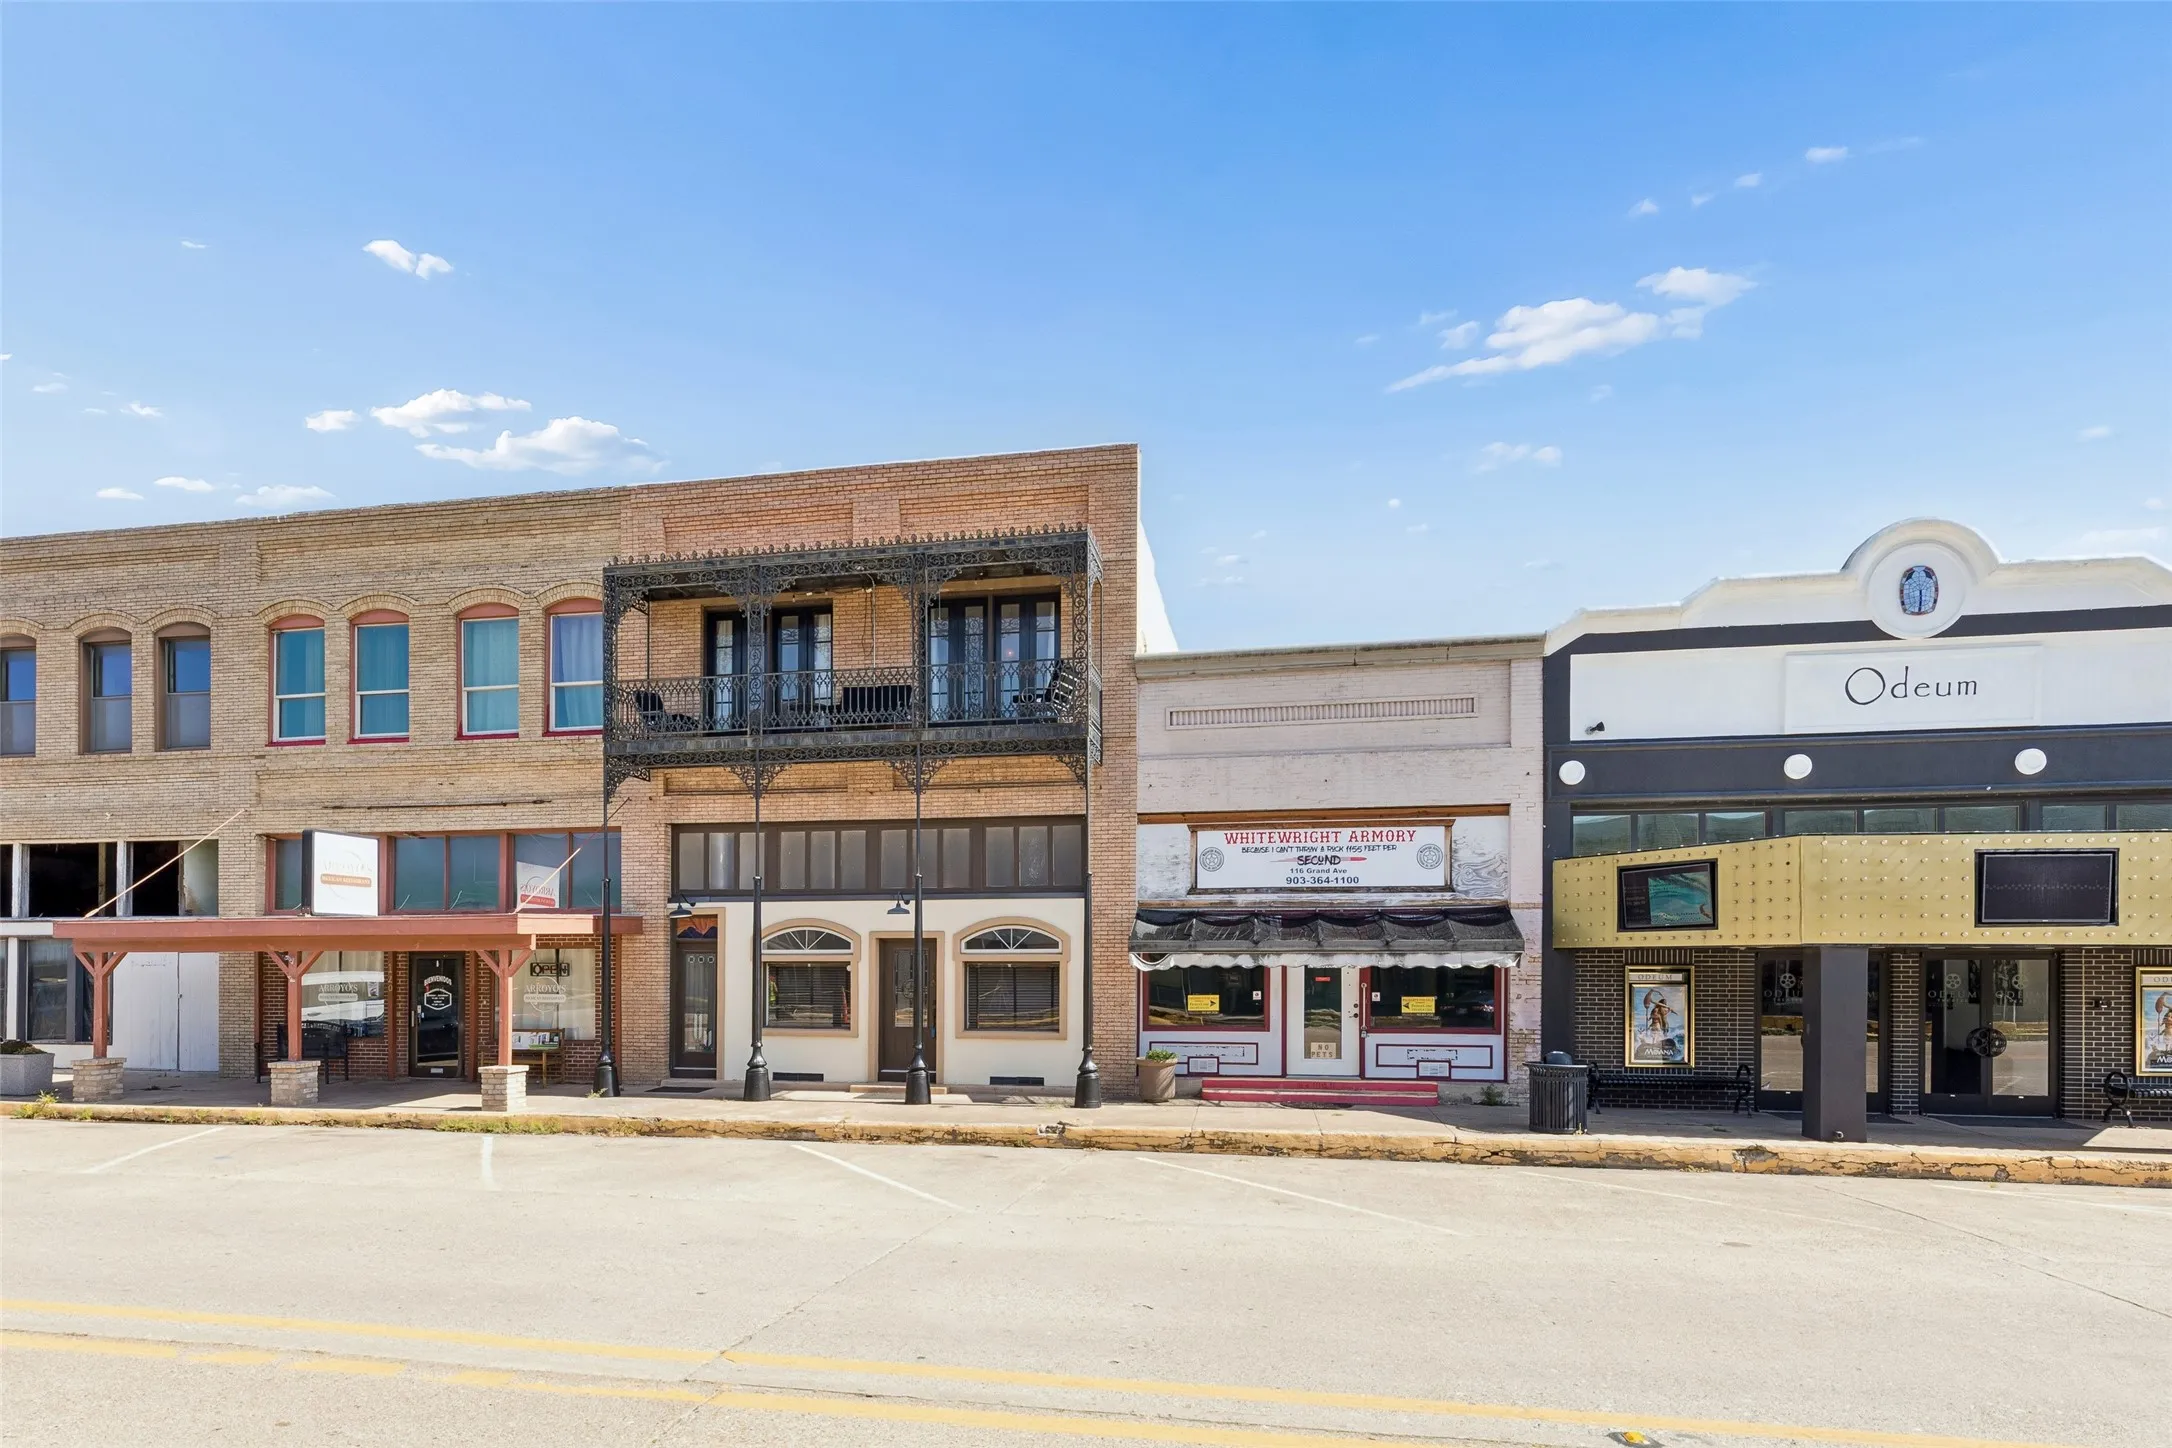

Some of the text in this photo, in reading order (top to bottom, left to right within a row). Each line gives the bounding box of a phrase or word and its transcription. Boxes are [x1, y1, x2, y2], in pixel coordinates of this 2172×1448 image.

[1845, 665, 1977, 705] Odeum
[1224, 829, 1417, 844] WHITEWRIGHT ARMORY
[1241, 846, 1269, 854] BECAUSE
[1276, 845, 1294, 853] CAN'T
[1363, 844, 1382, 852] FEET
[1383, 844, 1398, 852] PER
[1296, 854, 1342, 866] SECOND
[1285, 876, 1360, 885] 903-364-1100
[532, 963, 569, 976] OPEN
[319, 984, 358, 993] ARROYO'S
[525, 984, 567, 993] ARROYO'S
